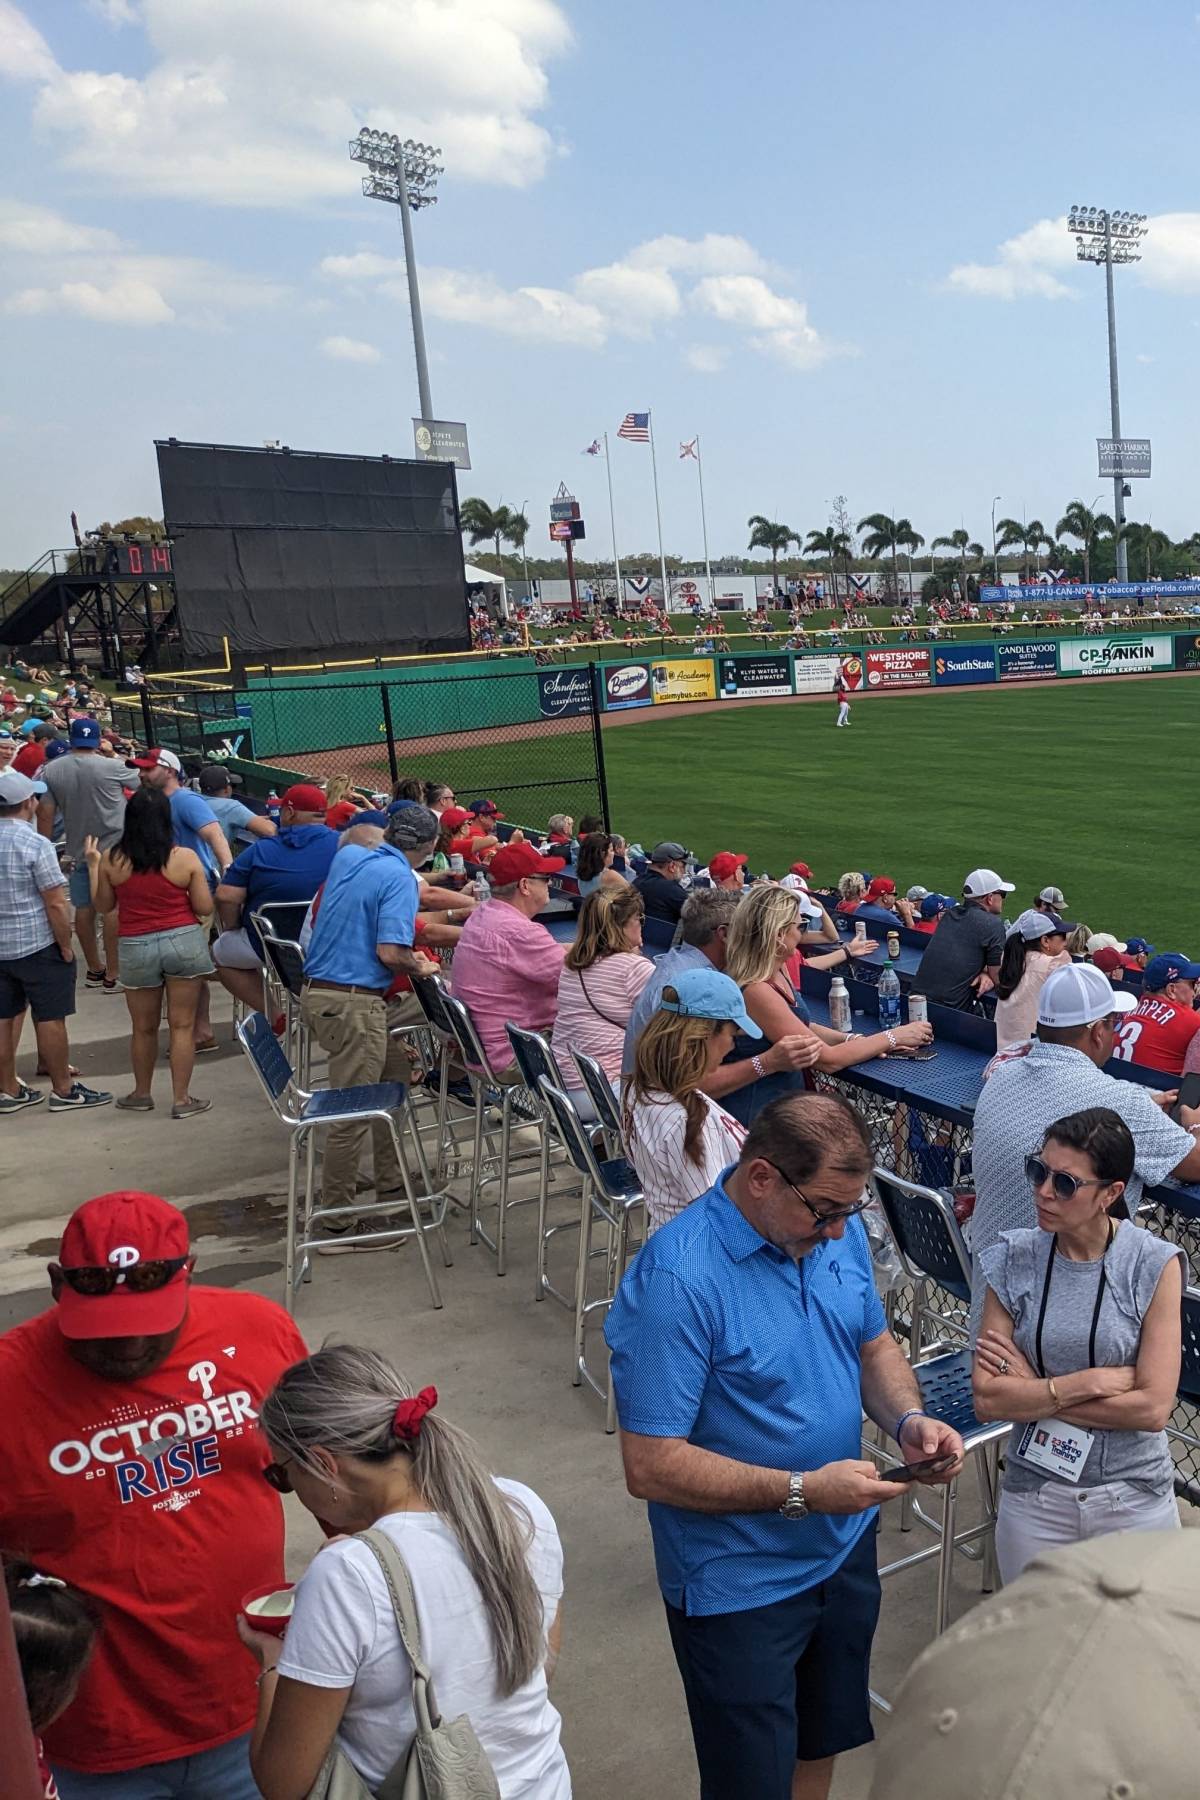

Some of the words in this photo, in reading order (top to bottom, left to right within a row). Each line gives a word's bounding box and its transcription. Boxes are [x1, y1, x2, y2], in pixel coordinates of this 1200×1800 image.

[999, 644, 1055, 655] CANDLEWOOD
[869, 651, 927, 662] WESTSHORE
[886, 661, 912, 670] PIZZA
[947, 659, 994, 671] SouthState
[677, 669, 711, 681] Academy
[50, 1391, 260, 1475] OCTOBER
[1051, 1445, 1077, 1463] Training
[1062, 1441, 1082, 1458] Spring
[115, 1435, 221, 1504] RISE
